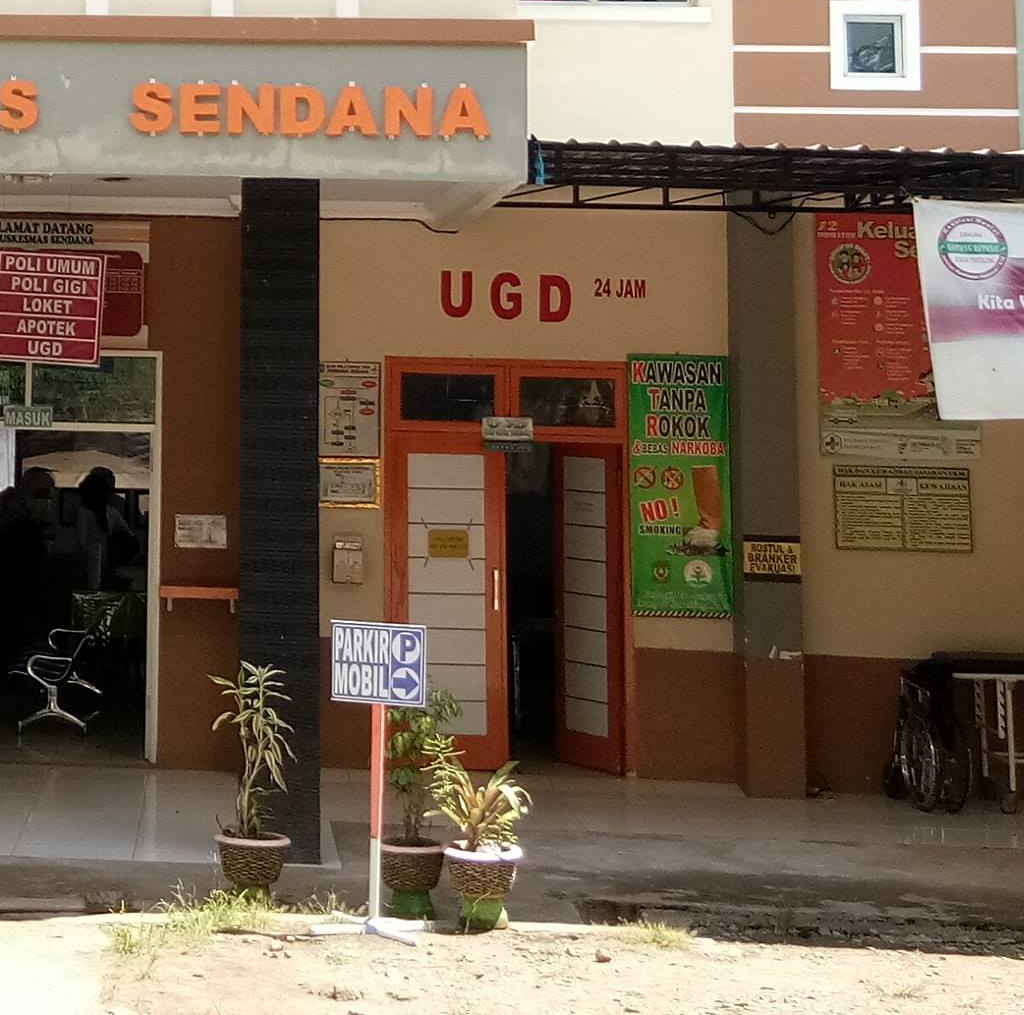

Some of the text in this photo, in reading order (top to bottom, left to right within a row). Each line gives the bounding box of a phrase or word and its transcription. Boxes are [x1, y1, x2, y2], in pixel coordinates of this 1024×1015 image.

[132, 84, 490, 138] SENDANA
[42, 223, 94, 235] DATANG
[50, 236, 94, 245] SENDANA
[4, 256, 96, 275] POLI UMUM
[10, 276, 87, 295] POLI GIGI
[593, 278, 646, 299] 24 JAM
[22, 297, 73, 314] LOKET
[441, 270, 573, 323] UGD
[977, 294, 1016, 310] Kita
[16, 320, 76, 336] APOTEK
[27, 340, 63, 357] UGD
[632, 361, 722, 385] KAWASAN
[648, 387, 707, 412] TANPA
[5, 411, 51, 426] MASUK
[646, 414, 710, 439] ROKOK
[670, 440, 725, 456] NARKOBA
[640, 498, 669, 522] NO
[639, 524, 682, 536] SMOKING
[747, 552, 797, 564] BRANKER
[334, 626, 389, 664] PARKIR
[400, 634, 417, 662] P
[334, 662, 389, 698] MOBIL
